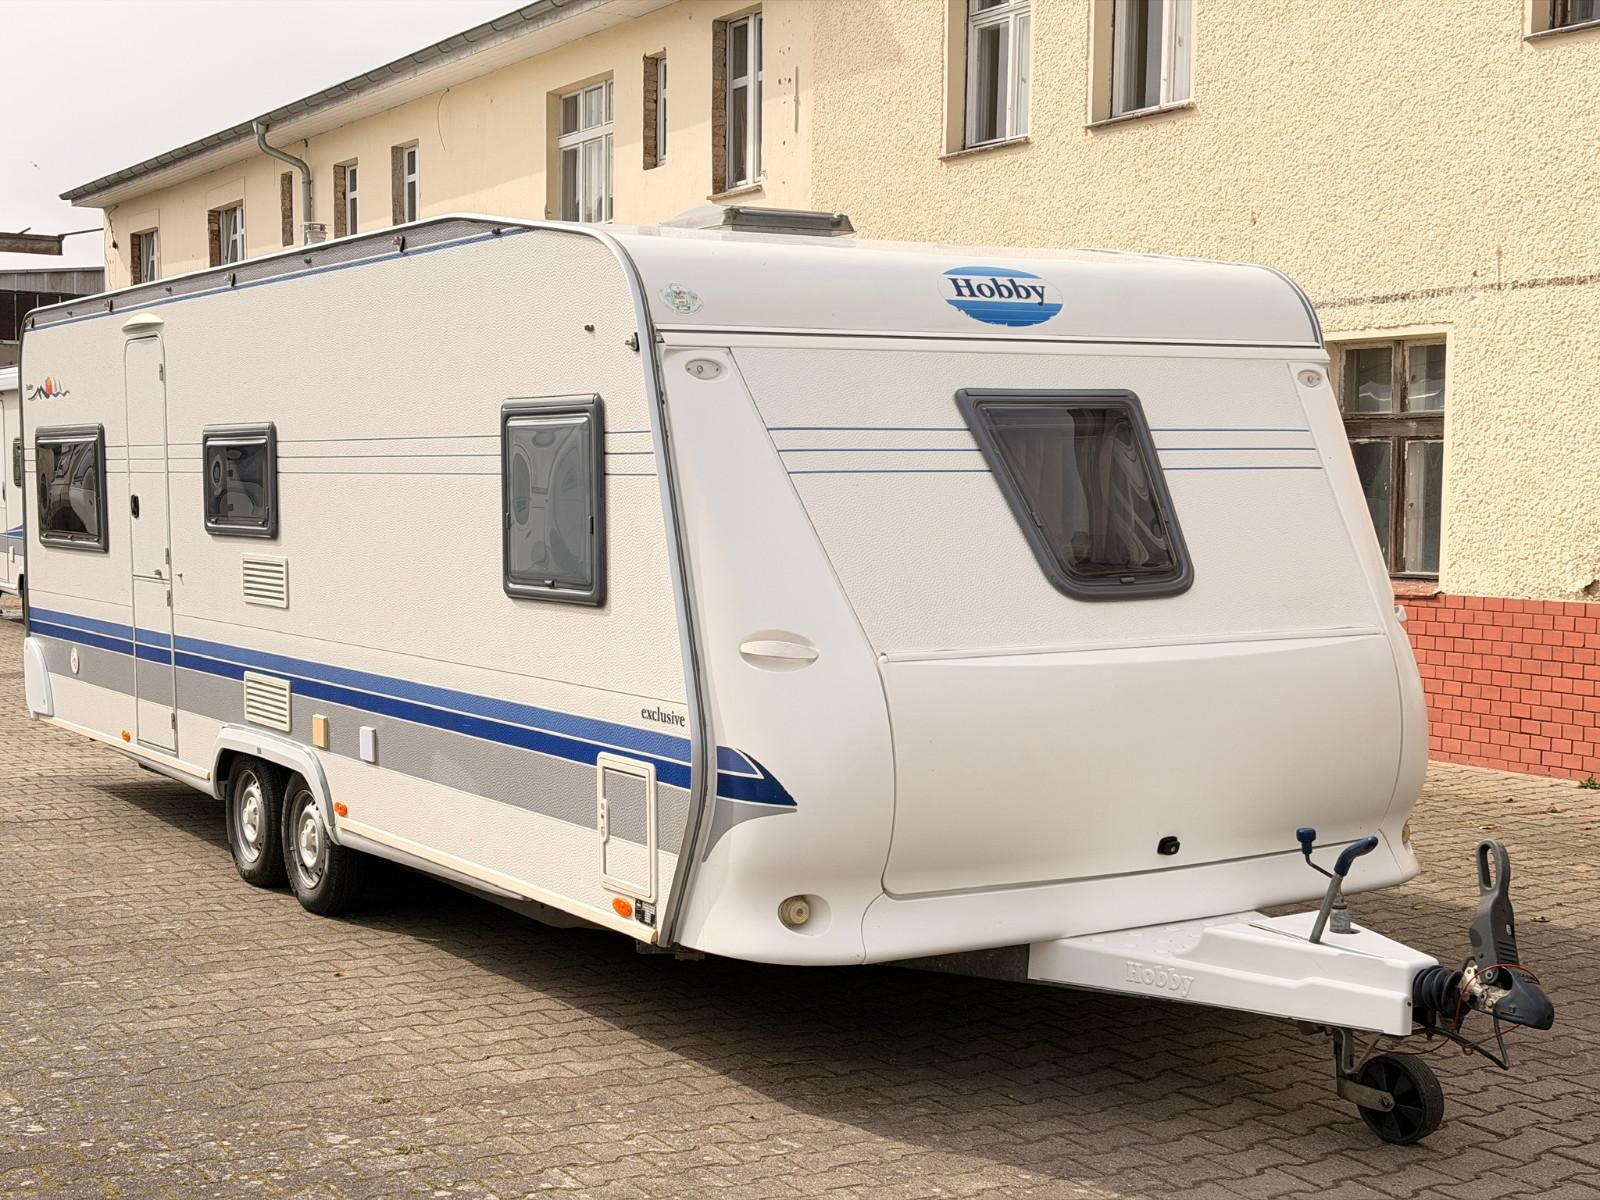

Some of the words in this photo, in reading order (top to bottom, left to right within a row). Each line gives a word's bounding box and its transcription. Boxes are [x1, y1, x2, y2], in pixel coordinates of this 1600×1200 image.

[947, 278, 1046, 306] Hobby
[641, 706, 686, 727] exclusive
[1126, 961, 1195, 998] Hobby
